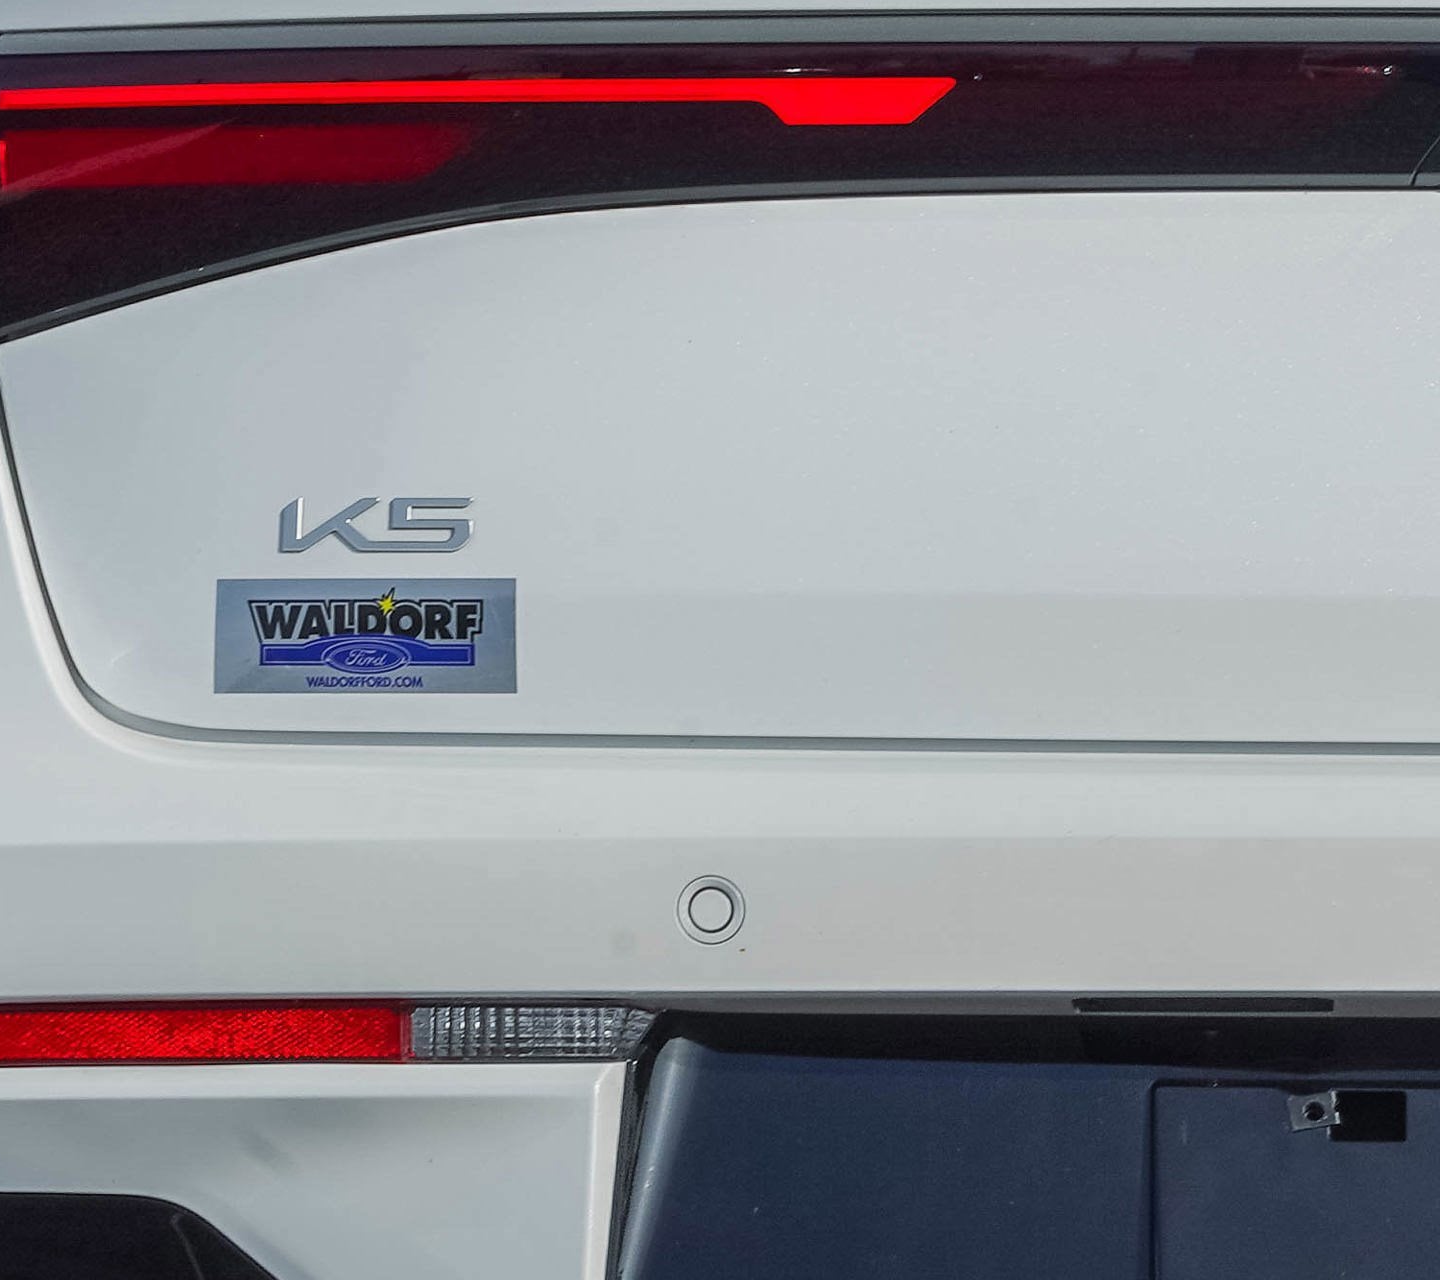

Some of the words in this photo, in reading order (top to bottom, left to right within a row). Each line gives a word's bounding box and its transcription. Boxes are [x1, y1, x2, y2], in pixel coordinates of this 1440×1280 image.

[278, 496, 475, 554] K5
[250, 600, 483, 641] WALDORF
[344, 648, 387, 667] Ford
[306, 675, 423, 689] WALDORFFORD.COM
